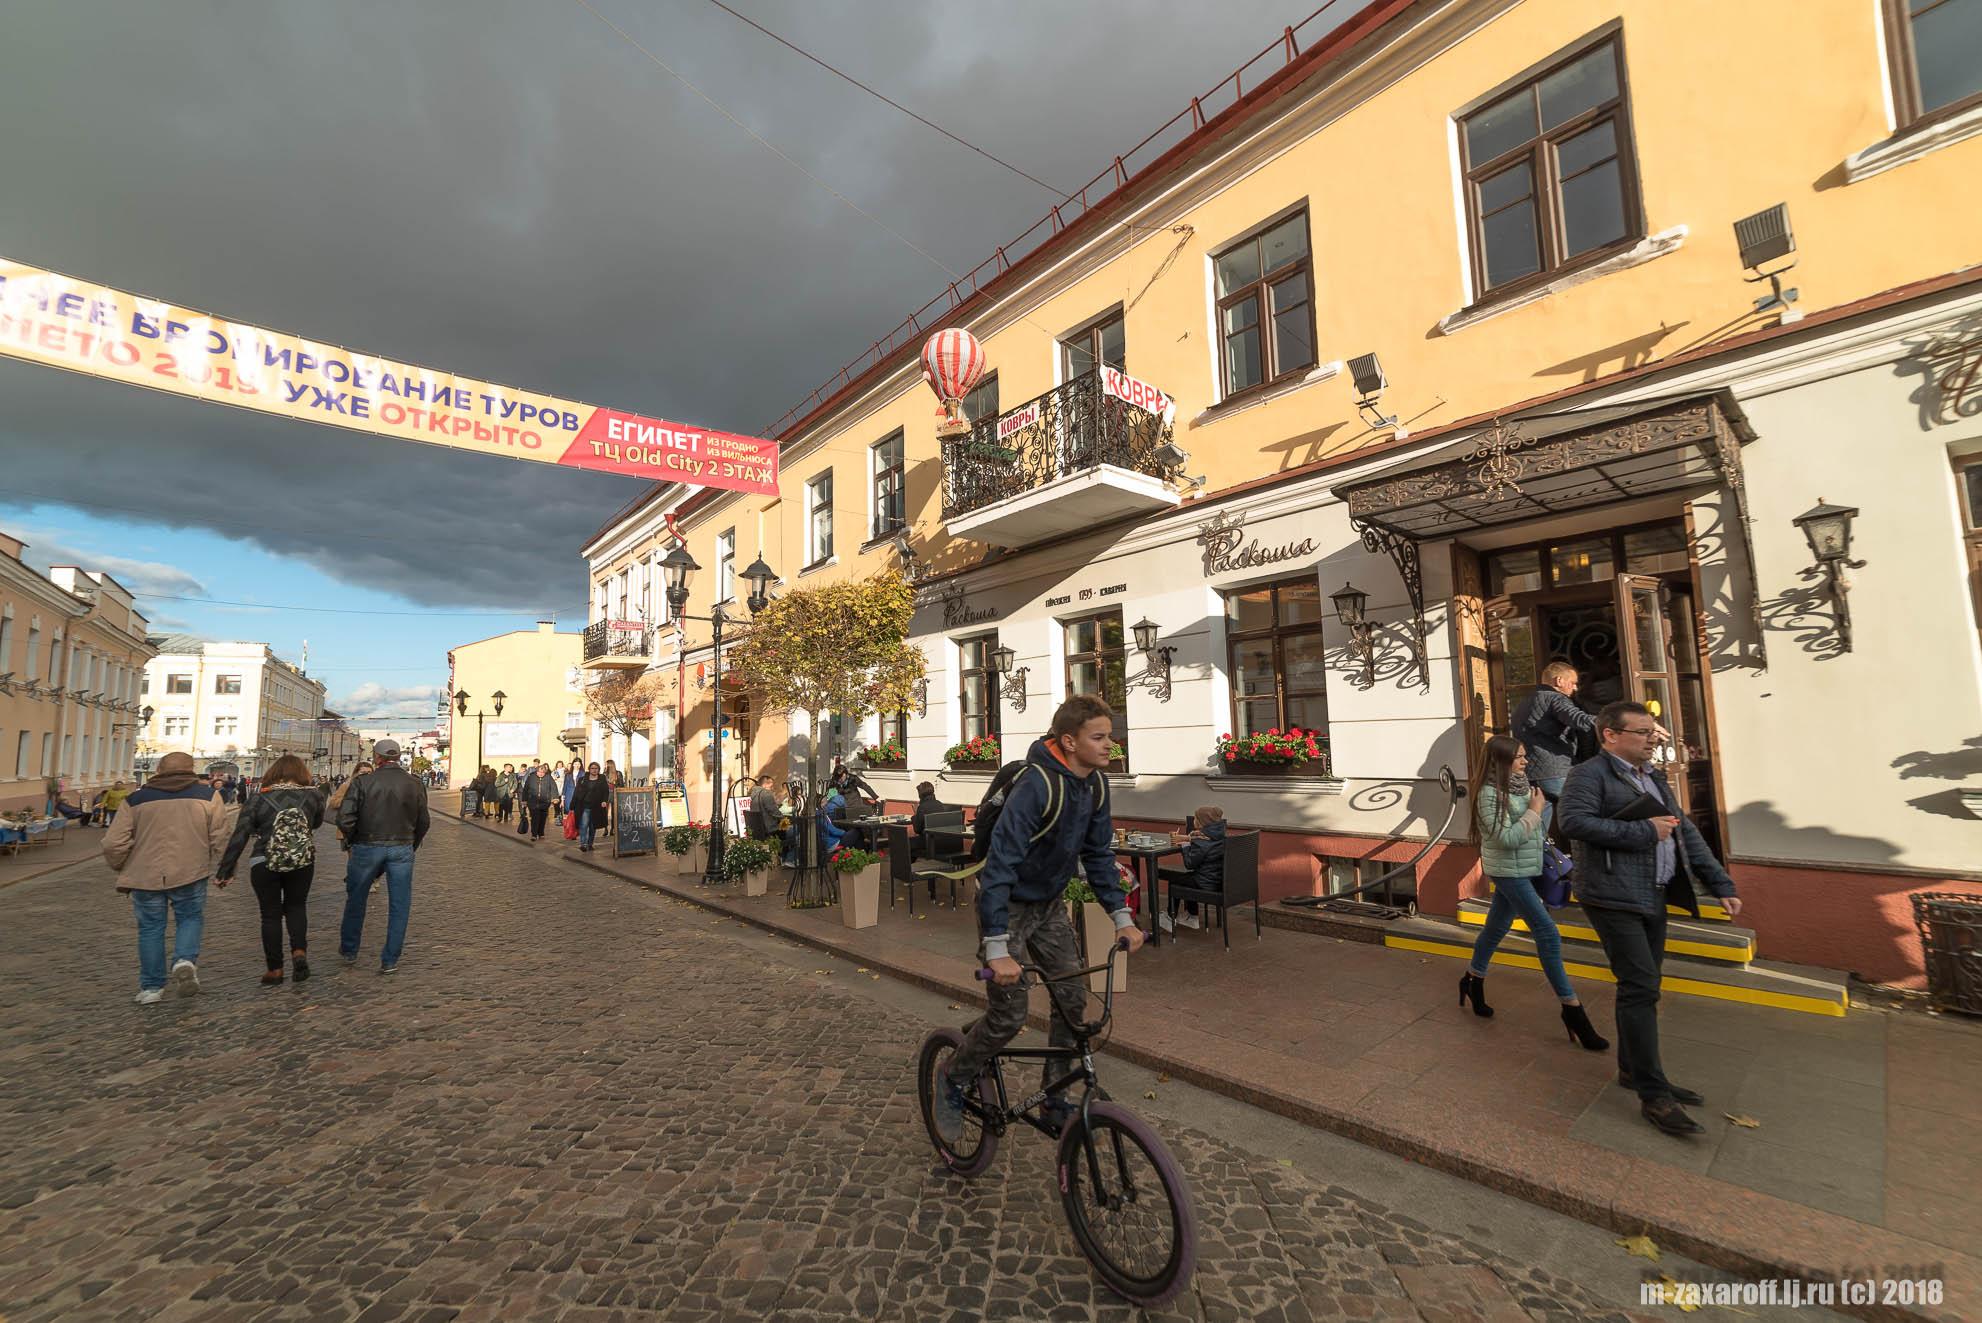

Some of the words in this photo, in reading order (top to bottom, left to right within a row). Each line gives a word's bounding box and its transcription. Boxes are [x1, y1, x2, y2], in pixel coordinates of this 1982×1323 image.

[283, 379, 370, 419] УЖЕ
[379, 402, 543, 449] ОТКРЫТО
[479, 394, 580, 432] ТУРОВ
[1000, 407, 1036, 436] КОВРЫ
[608, 417, 702, 453] ЕГИПЕТ
[707, 436, 720, 446] ИЗ
[721, 439, 760, 454] ГРОДНО
[589, 440, 621, 464] ТЦ
[625, 445, 662, 467] Old
[666, 452, 705, 477] City
[708, 460, 720, 476] 2
[723, 461, 774, 485] ЭТАЖ
[707, 447, 720, 457] ИЗ
[721, 449, 773, 467] ВИЛЬНЮСА
